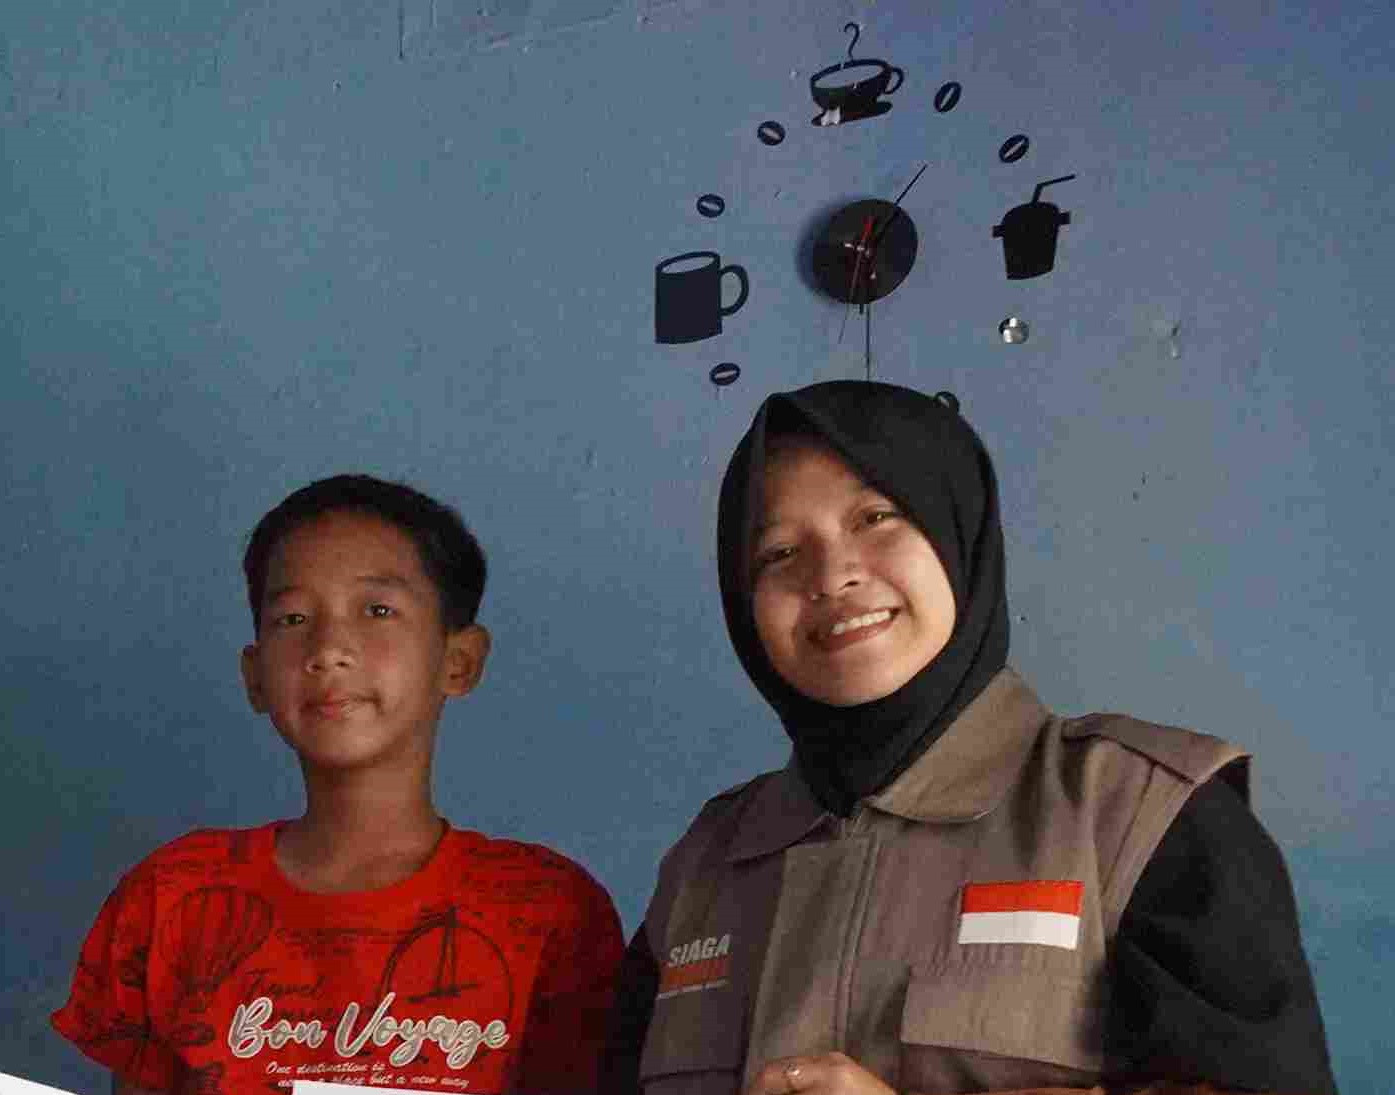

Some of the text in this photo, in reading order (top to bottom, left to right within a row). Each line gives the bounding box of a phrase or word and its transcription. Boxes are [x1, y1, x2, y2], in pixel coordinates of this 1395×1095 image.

[668, 934, 731, 968] SIAGA
[227, 991, 510, 1071] Bon Voyage
